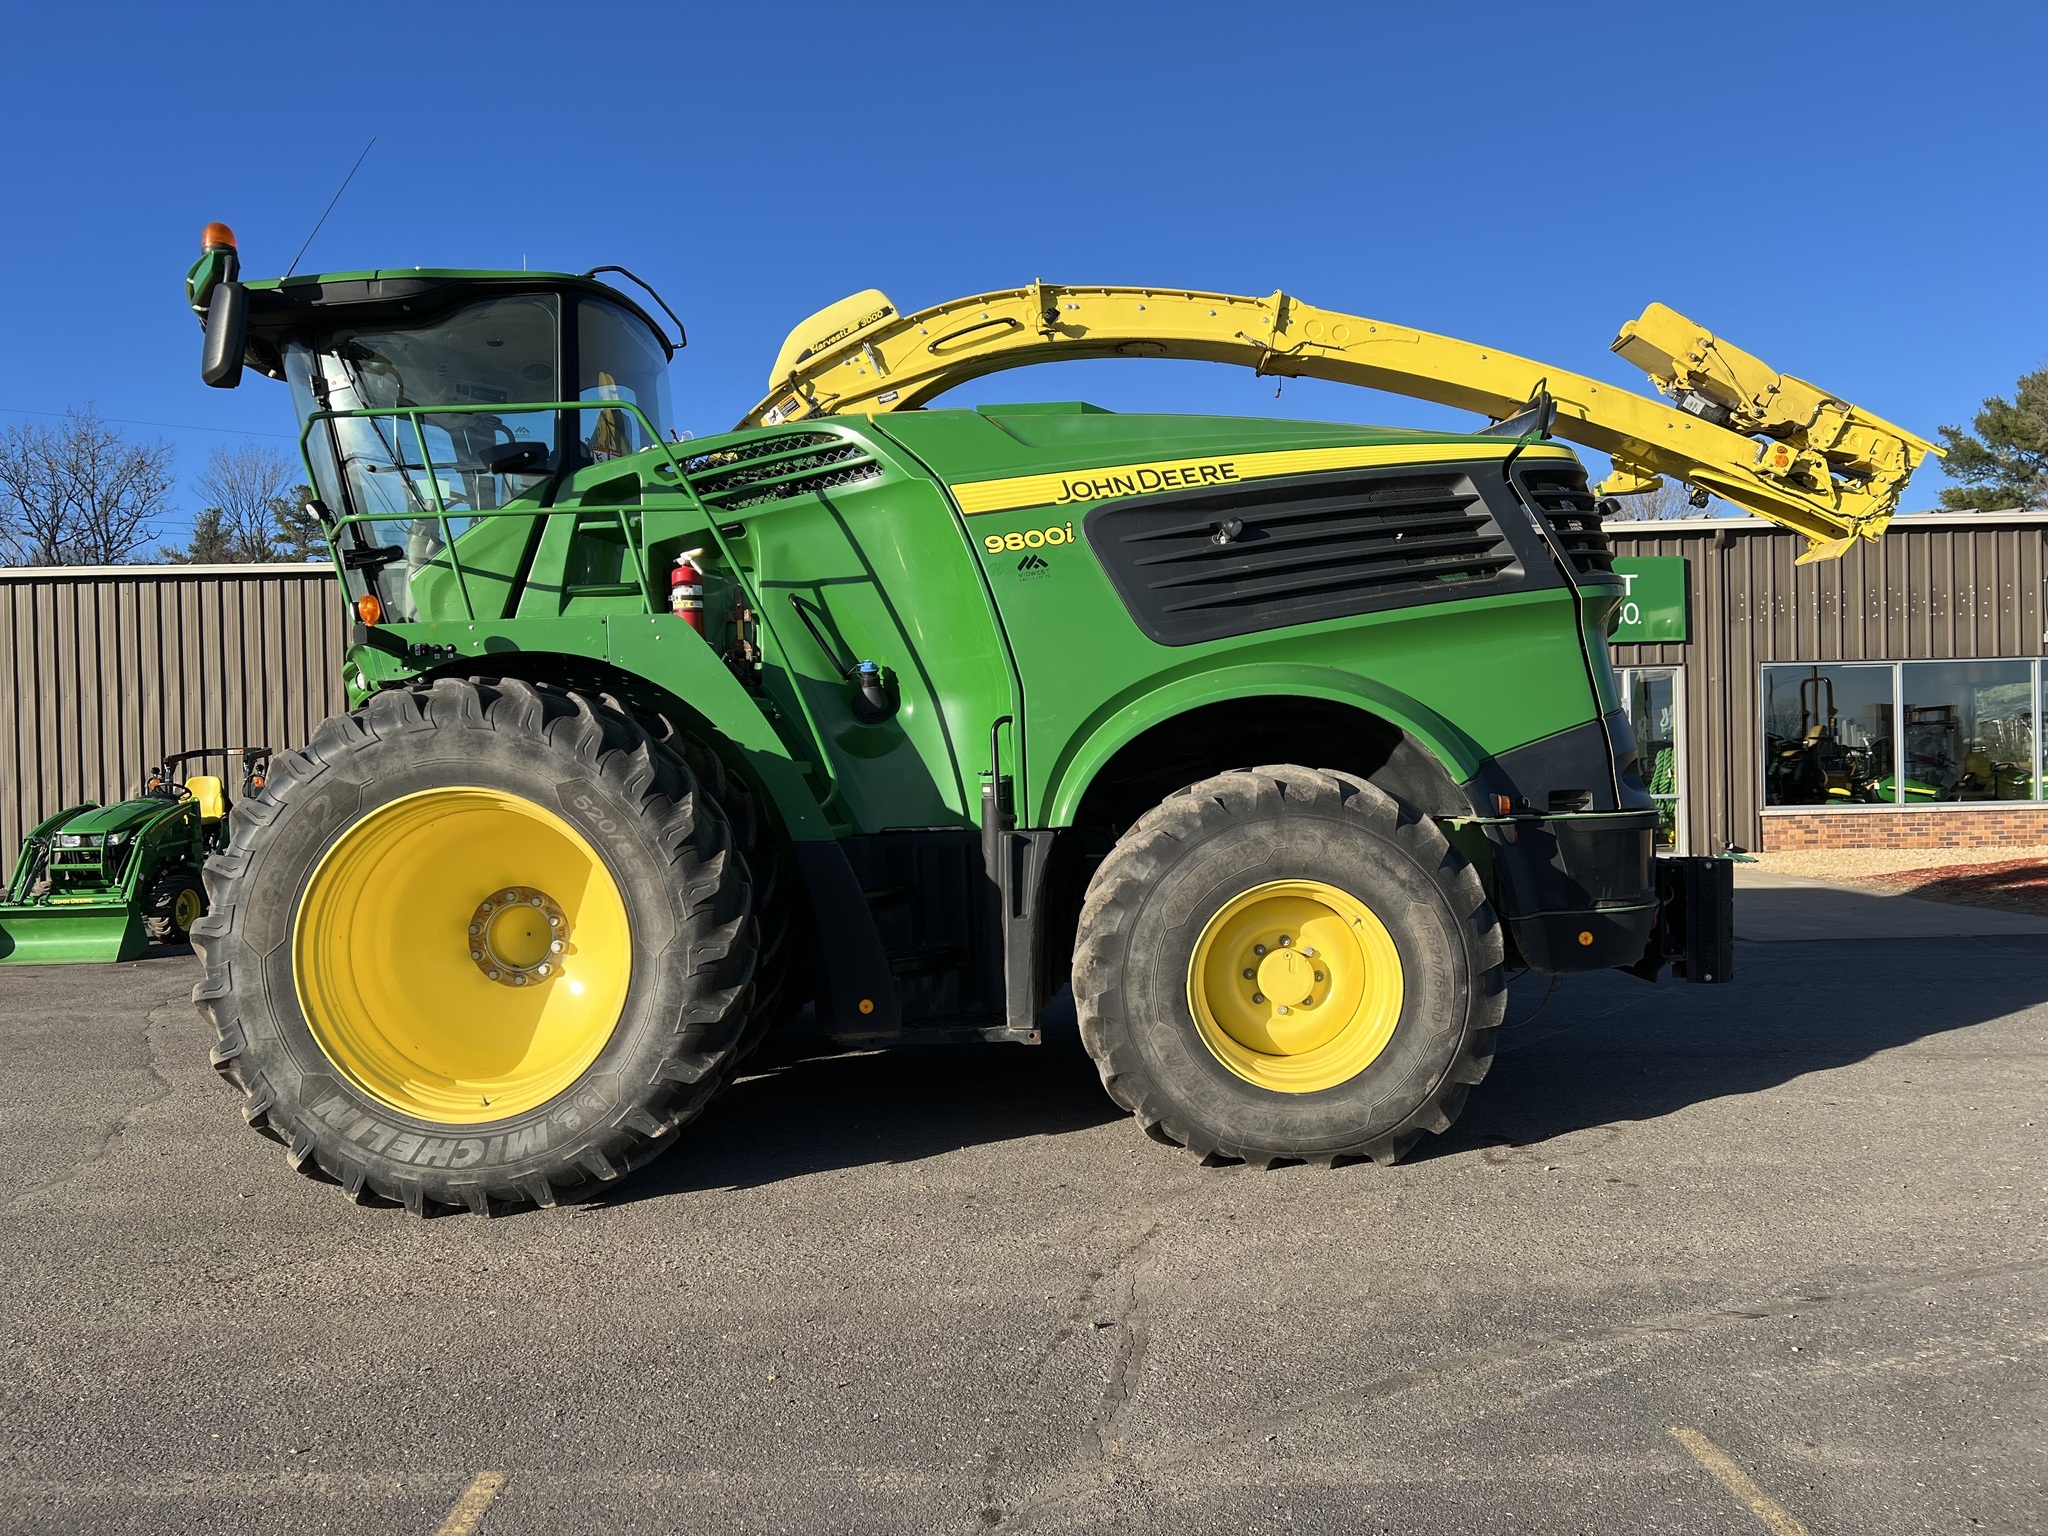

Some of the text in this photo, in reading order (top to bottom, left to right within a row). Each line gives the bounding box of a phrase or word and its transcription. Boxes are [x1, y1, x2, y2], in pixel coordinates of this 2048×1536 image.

[810, 310, 884, 354] HarvestL 3000
[1057, 462, 1240, 501] JOHN DEERE
[984, 520, 1076, 554] 9800i
[1618, 602, 1642, 625] O.
[312, 1096, 549, 1169] MICHELIN
